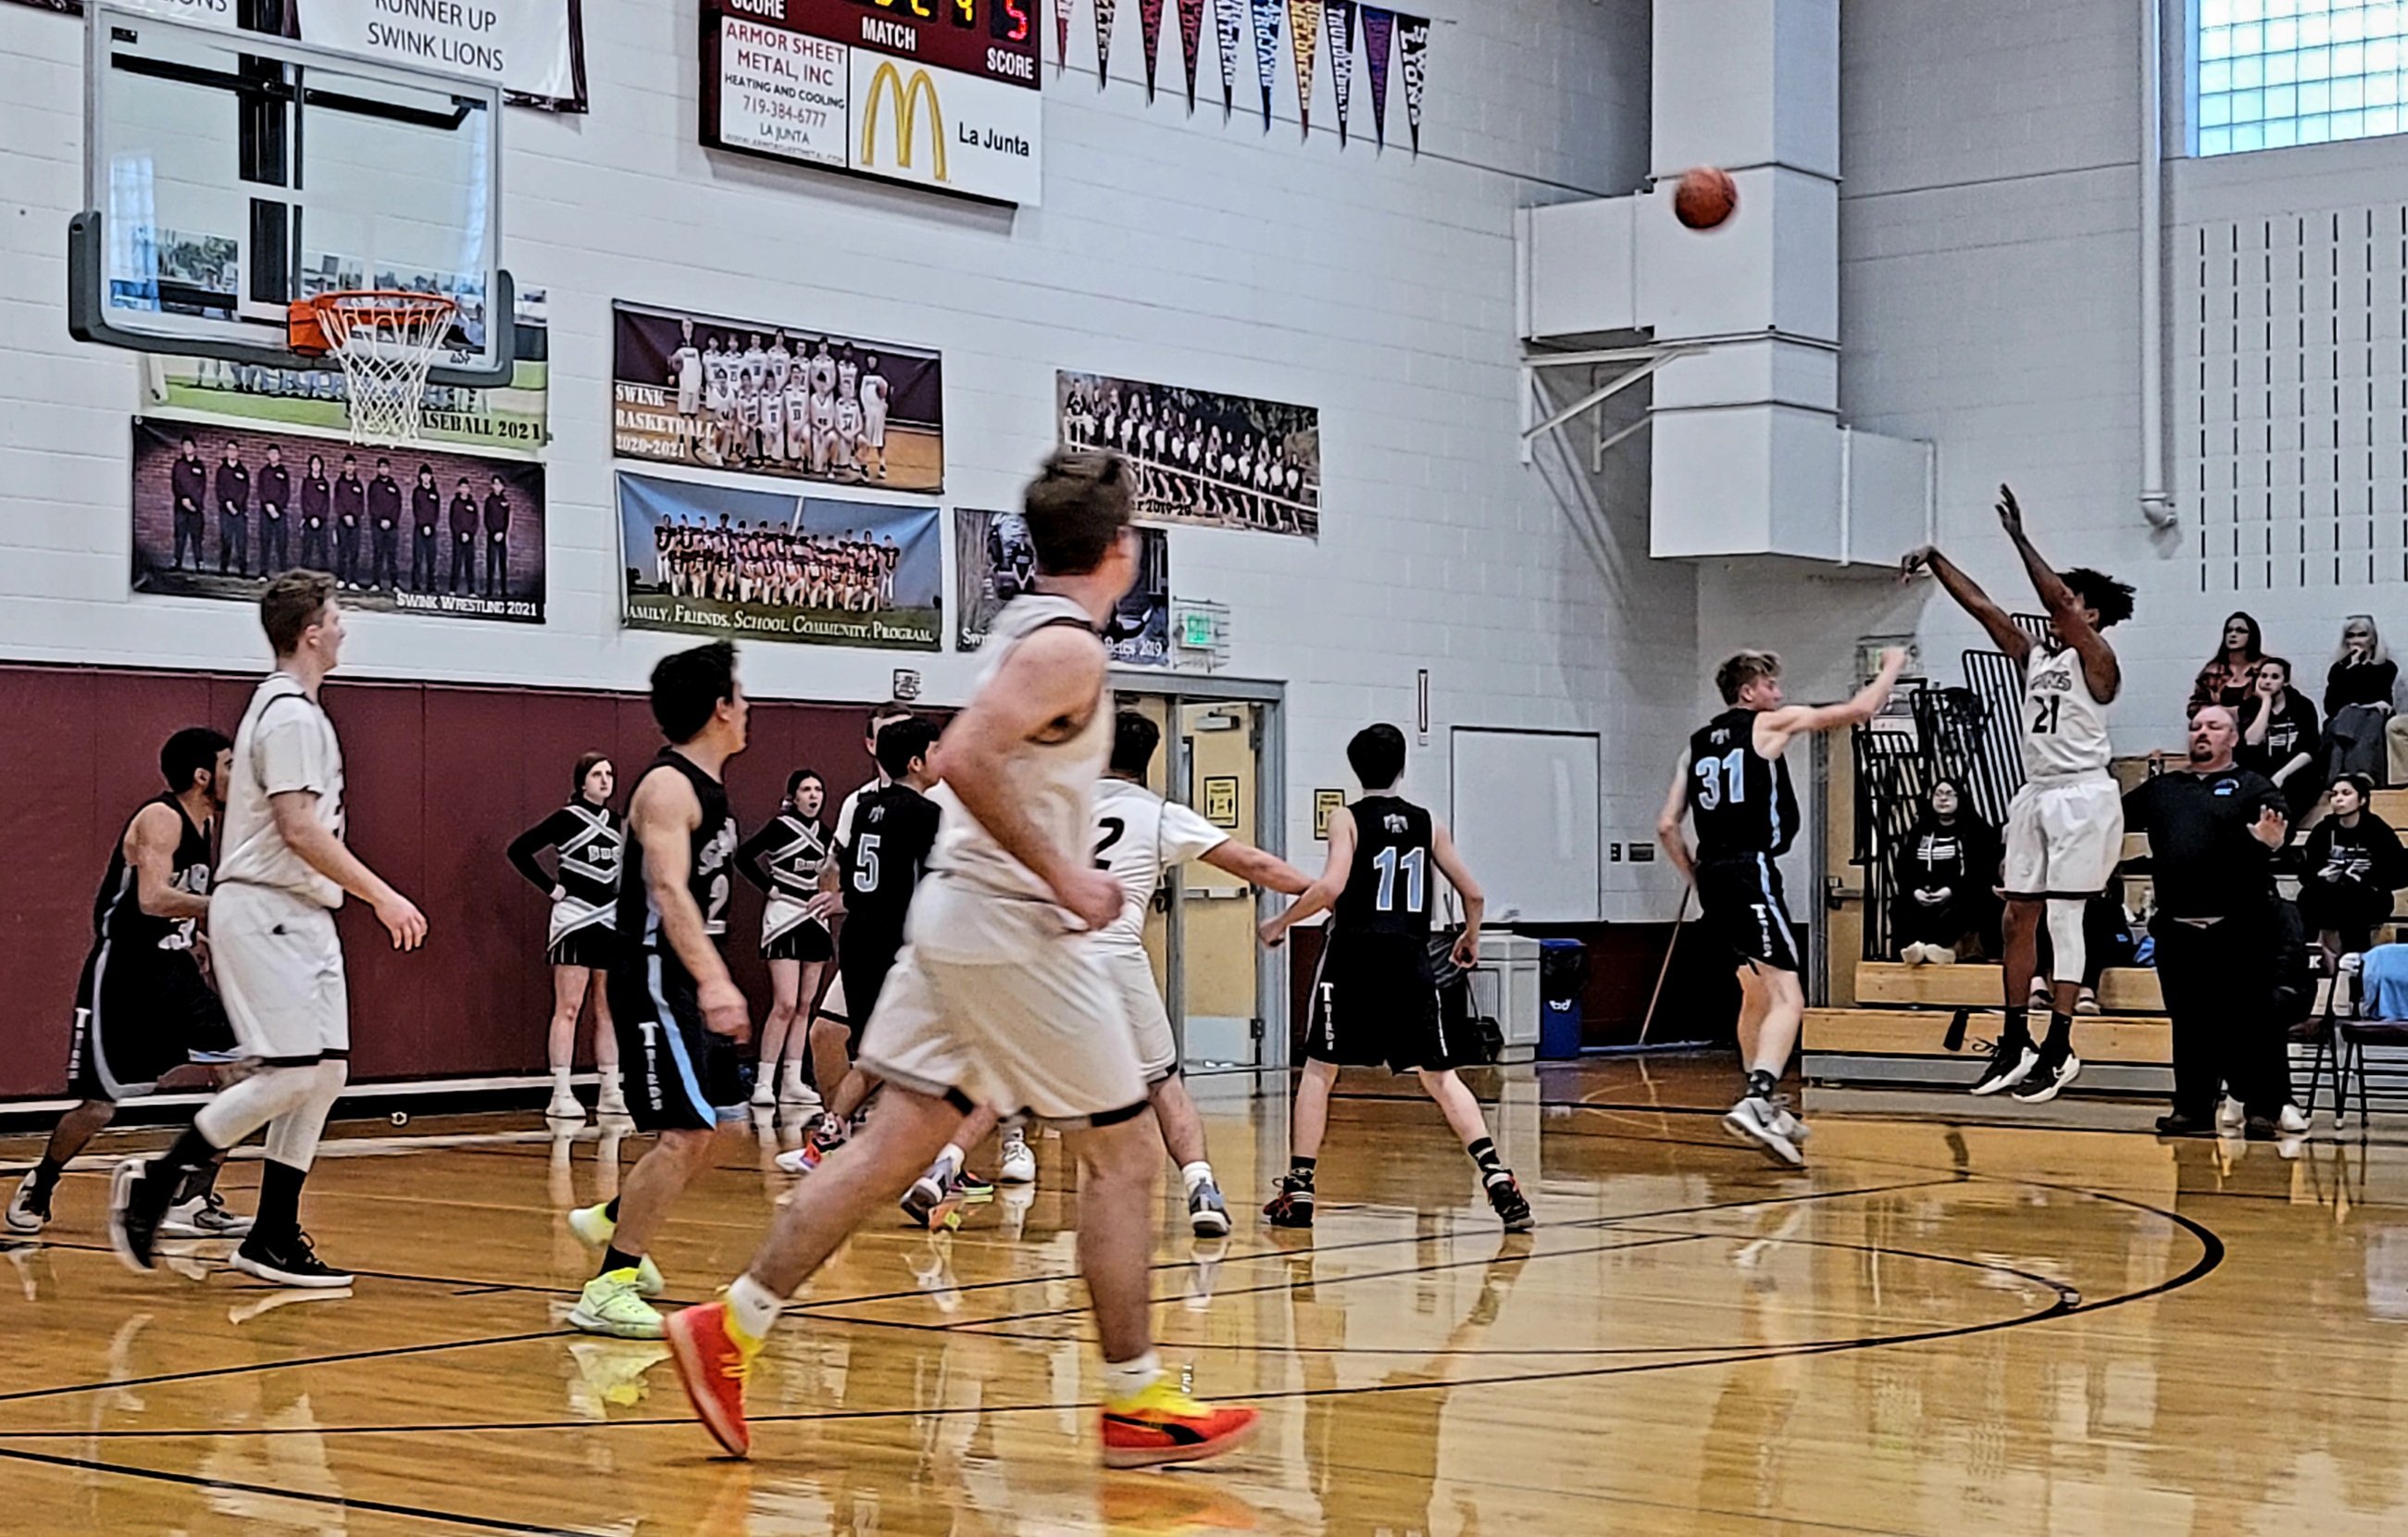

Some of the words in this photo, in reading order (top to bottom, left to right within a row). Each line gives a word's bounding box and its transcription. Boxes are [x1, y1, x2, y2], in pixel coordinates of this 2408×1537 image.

[468, 6, 497, 32] UP
[862, 16, 917, 51] MATCH
[367, 22, 437, 57] SWINK
[443, 38, 504, 71] LIONS
[726, 22, 788, 51] ARMOR
[792, 38, 844, 64] SHEET
[804, 64, 834, 86] INC
[987, 47, 1034, 80] SCORE
[725, 73, 771, 94] HEATING
[773, 84, 796, 98] AND
[798, 90, 845, 109] COOLING
[760, 122, 774, 137] LA
[775, 126, 810, 145] JUNTA
[959, 120, 979, 146] La
[983, 128, 1029, 157] Junta
[615, 383, 666, 407] SWINK
[418, 411, 493, 435] ASEBALL
[498, 420, 541, 440] 2021
[615, 408, 716, 439] BASKETBALL
[506, 602, 537, 616] 2021
[2031, 694, 2061, 734] 21
[1695, 748, 1745, 810] 31
[854, 832, 881, 893] 5
[1373, 845, 1425, 913] 11
